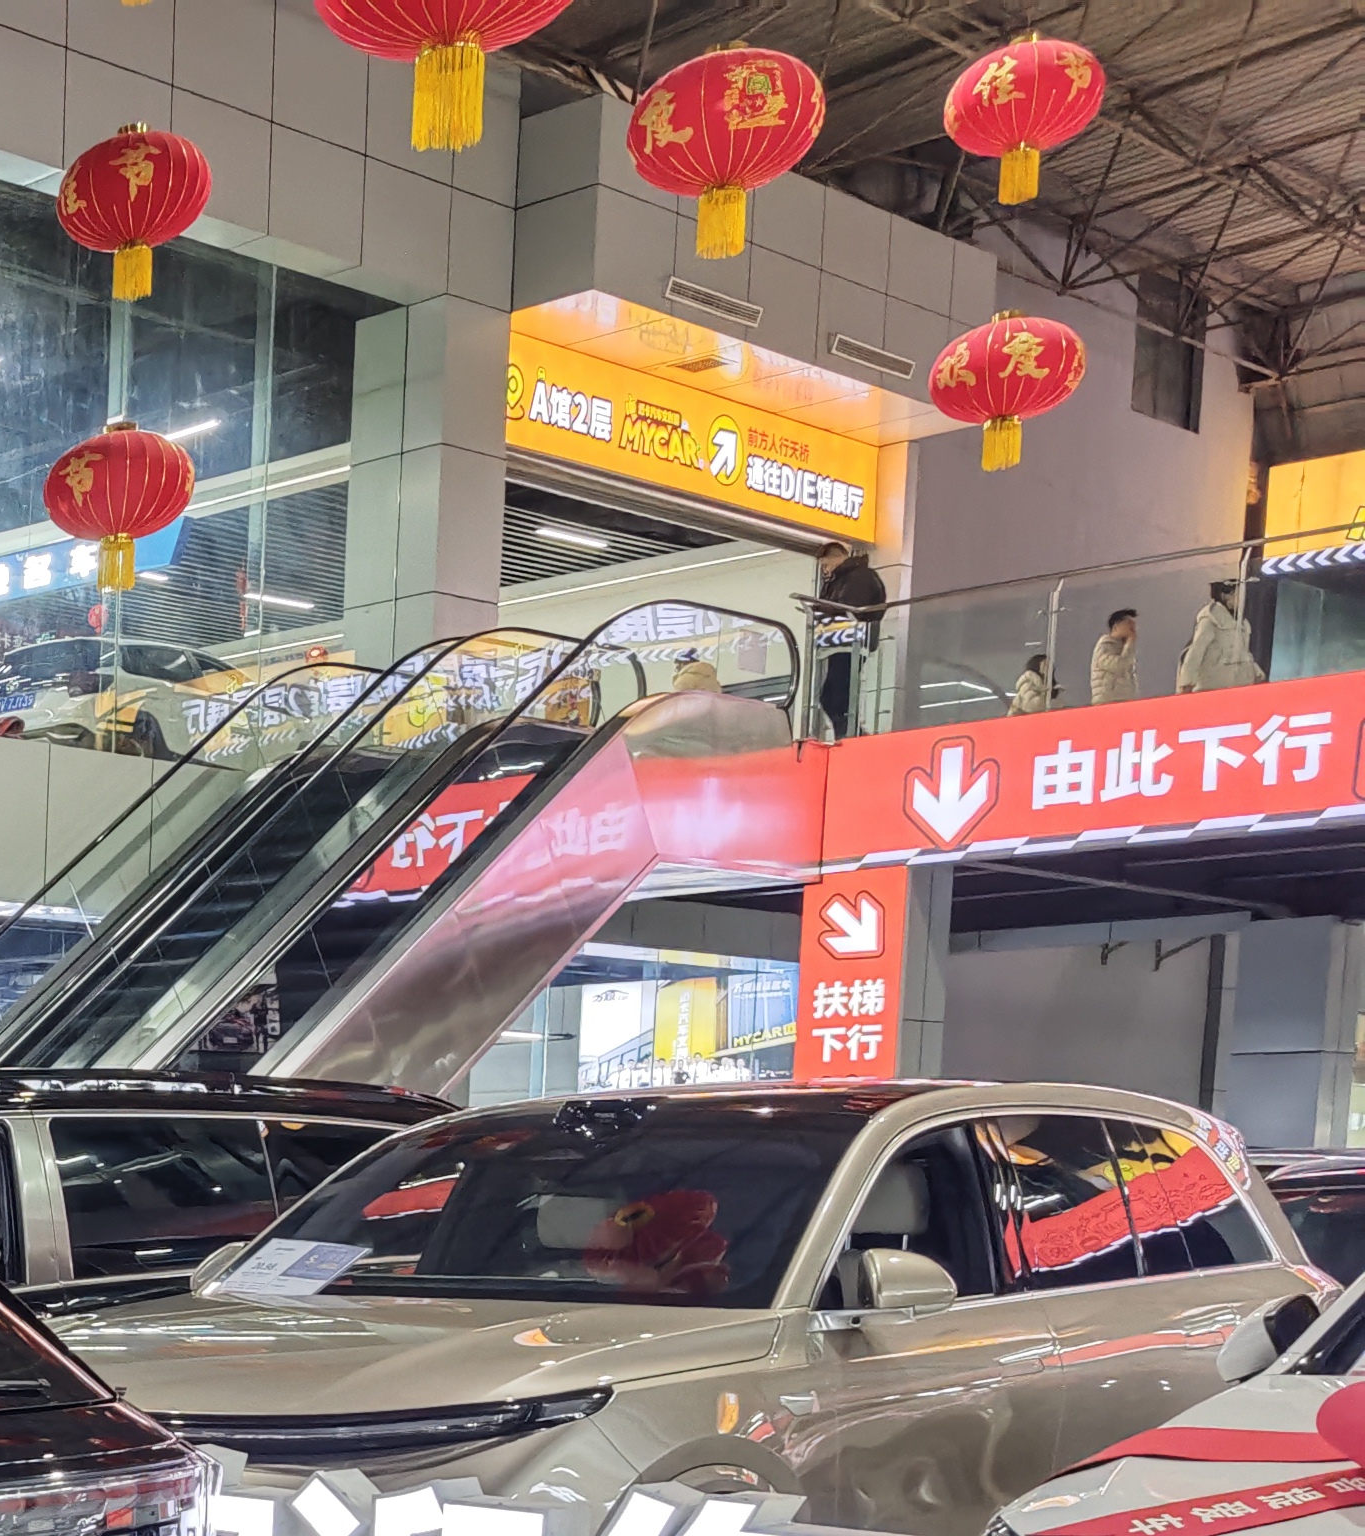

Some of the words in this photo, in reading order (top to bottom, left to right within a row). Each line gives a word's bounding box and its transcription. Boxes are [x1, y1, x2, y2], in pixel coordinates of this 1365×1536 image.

[529, 378, 613, 442] A馆2层
[619, 414, 703, 469] MYCAR
[747, 426, 810, 464] 前方人行天桥
[745, 454, 865, 520] 通往D/E馆展厅
[1031, 710, 1333, 810] 由此下行
[811, 978, 886, 1020] 扶梯
[811, 1024, 885, 1064] 下行
